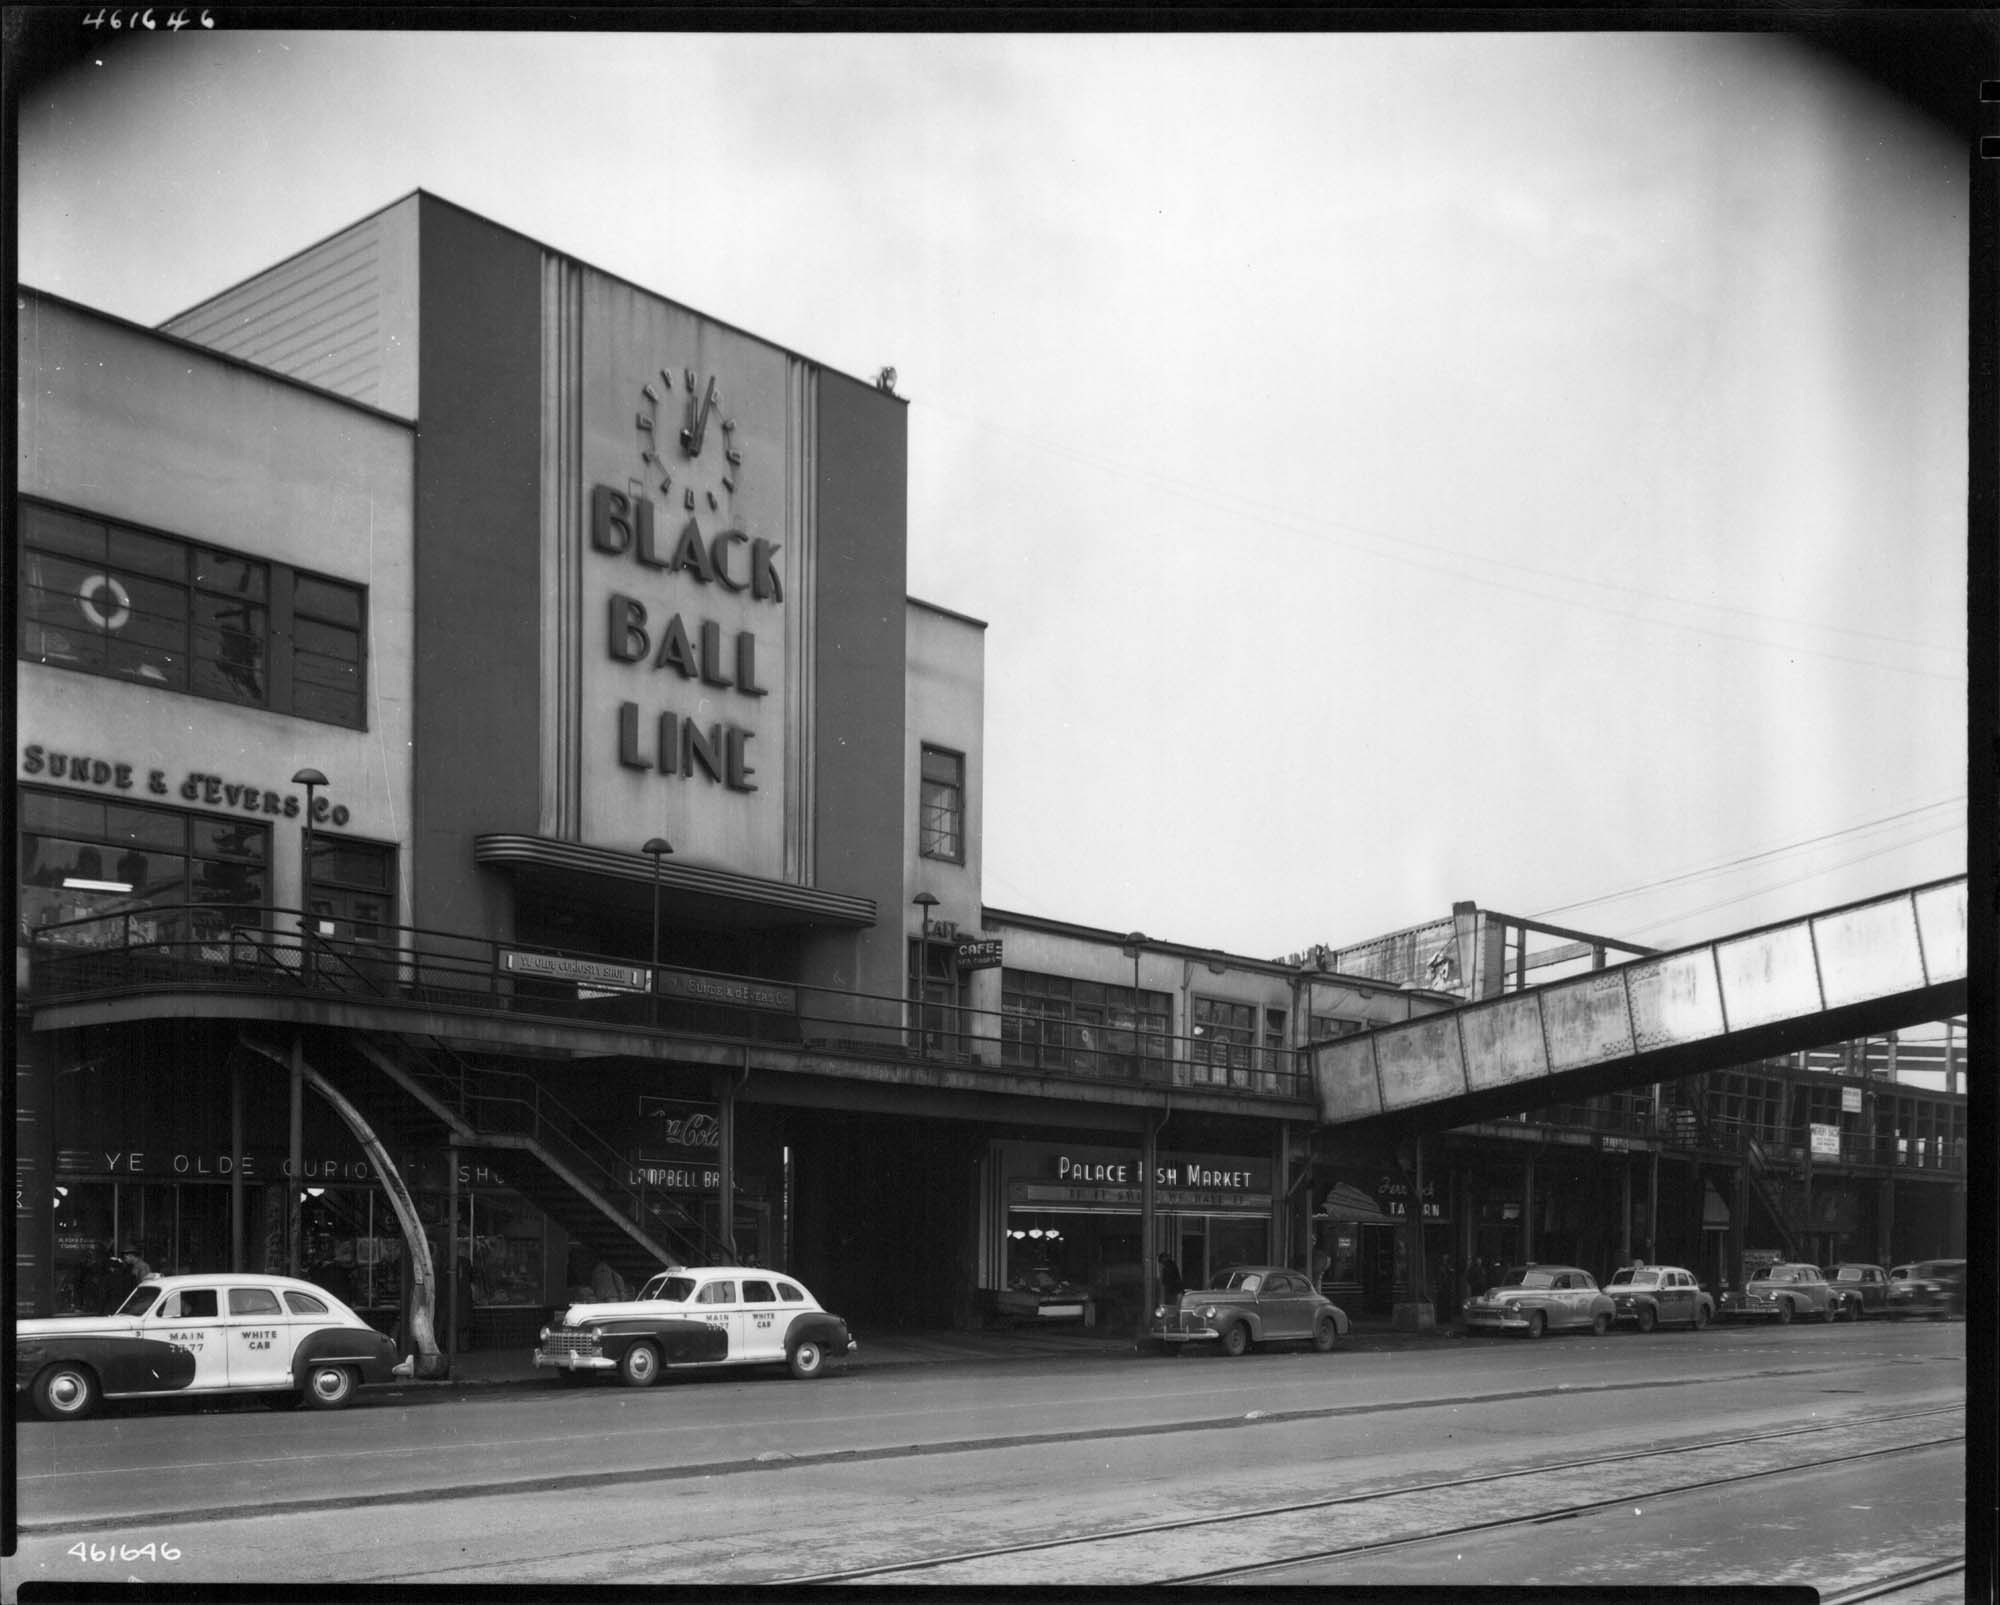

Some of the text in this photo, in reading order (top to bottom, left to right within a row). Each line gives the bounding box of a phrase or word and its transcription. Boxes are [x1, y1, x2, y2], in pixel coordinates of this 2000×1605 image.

[592, 484, 783, 604] BLACK
[608, 593, 769, 697] BALL
[619, 701, 758, 794] LINE
[23, 744, 134, 790] SUNDE
[149, 770, 168, 795] &
[959, 942, 995, 956] CAFE
[104, 1153, 145, 1172] YE
[173, 1154, 256, 1175] OLDE
[282, 1160, 426, 1184] CURIO
[1060, 1155, 1253, 1188] PALACE SH MARKET
[1389, 1202, 1441, 1217] TARN
[752, 1312, 775, 1320] WHITE
[756, 1321, 771, 1329] CAB
[169, 1332, 204, 1341] MAIN
[242, 1330, 277, 1339] WHITE
[249, 1341, 271, 1350] CAB
